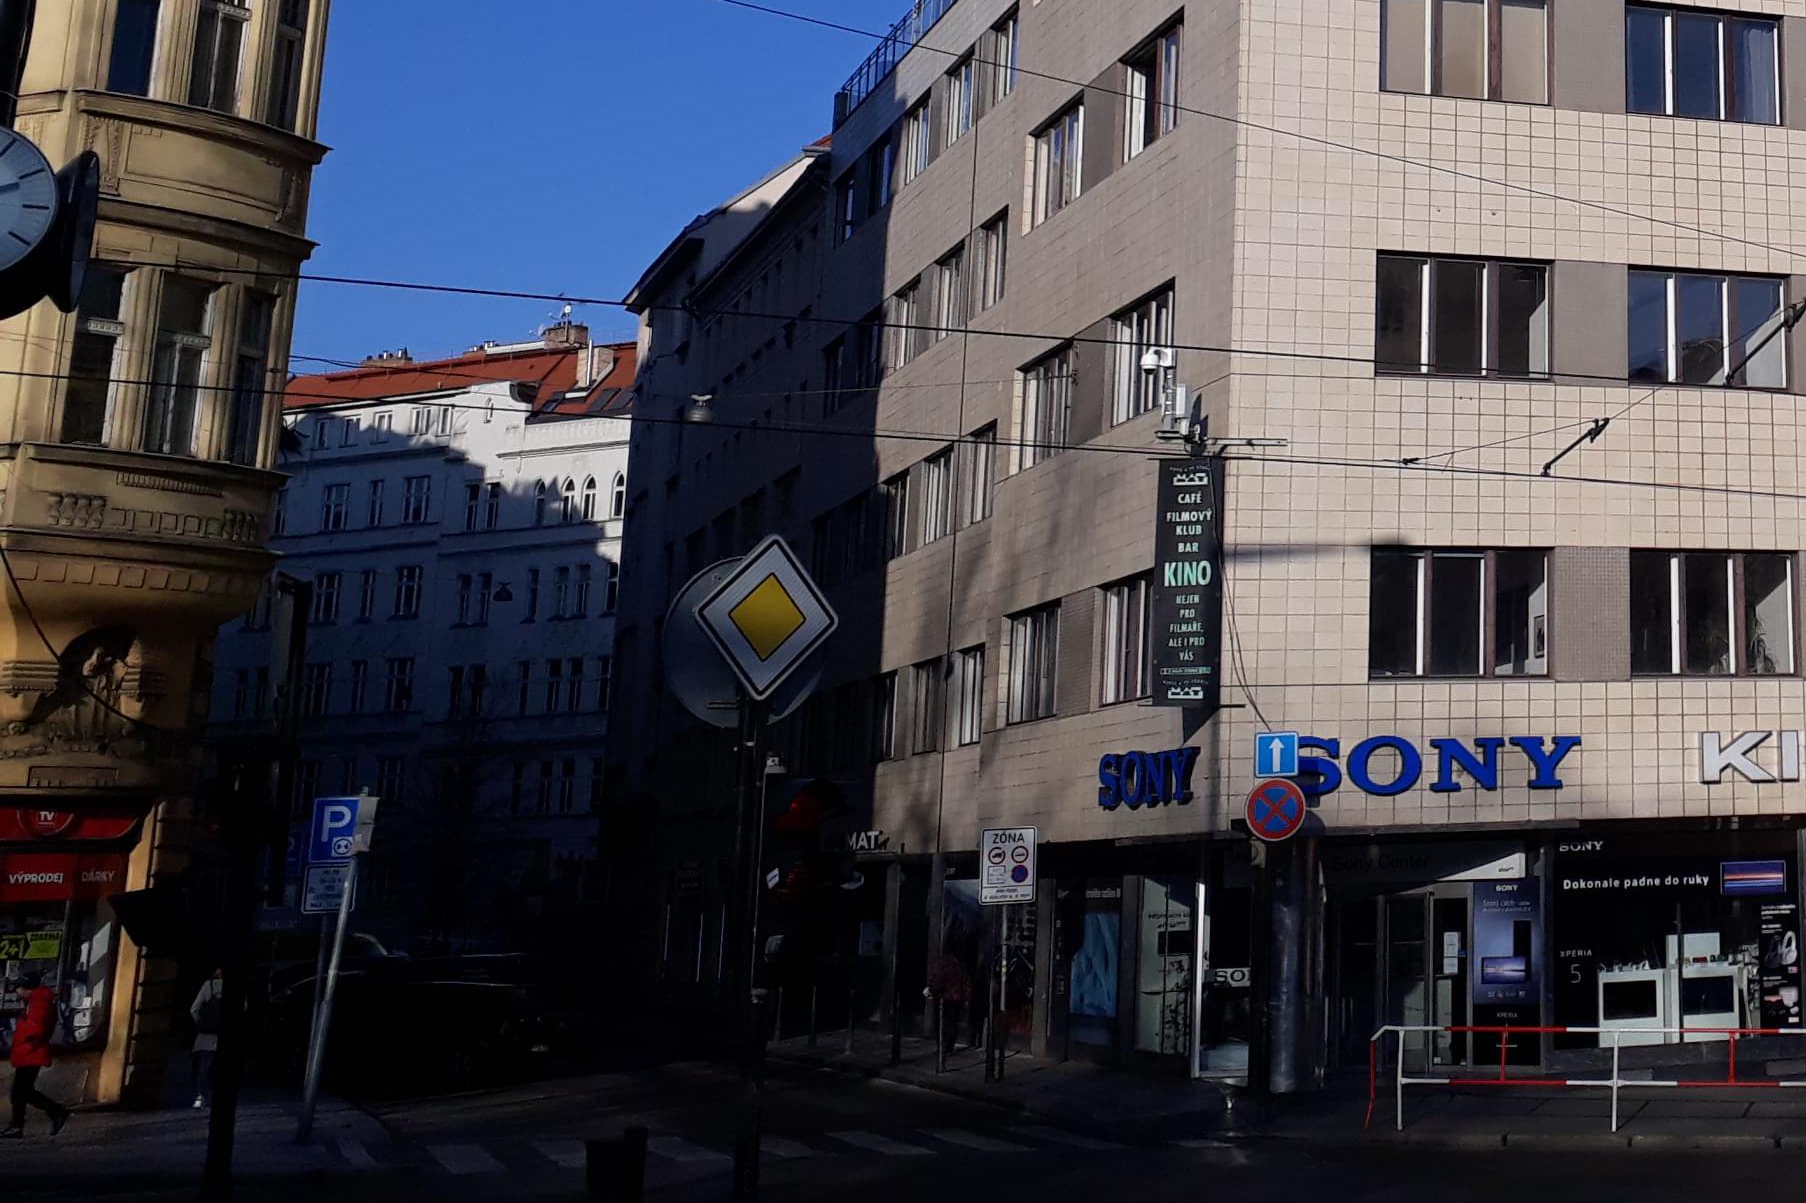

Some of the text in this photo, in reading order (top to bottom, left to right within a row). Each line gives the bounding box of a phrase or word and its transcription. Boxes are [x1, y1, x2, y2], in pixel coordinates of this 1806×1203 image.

[1177, 491, 1203, 504] CAFÉ
[1166, 508, 1213, 522] FILMOVÝ
[1176, 524, 1203, 536] KLUB
[1178, 542, 1200, 553] BAR
[1163, 560, 1212, 588] KINO
[1179, 609, 1196, 619] PRO
[1168, 637, 1185, 647] ALE
[1189, 636, 1206, 646] PRO
[1179, 649, 1195, 661] VÁS
[1298, 735, 1582, 796] SONY
[1098, 746, 1201, 811] SONY
[40, 810, 55, 821] TV
[321, 805, 352, 843] P
[992, 830, 1025, 844] ZÓNA
[1559, 840, 1605, 853] SONY
[8, 870, 64, 885] VÝPRODEJ
[81, 867, 116, 882] DÁRKY
[1563, 873, 1710, 891] Dokonale padne do ruky
[1559, 949, 1593, 958] XPERIA
[1570, 963, 1582, 984] 5
